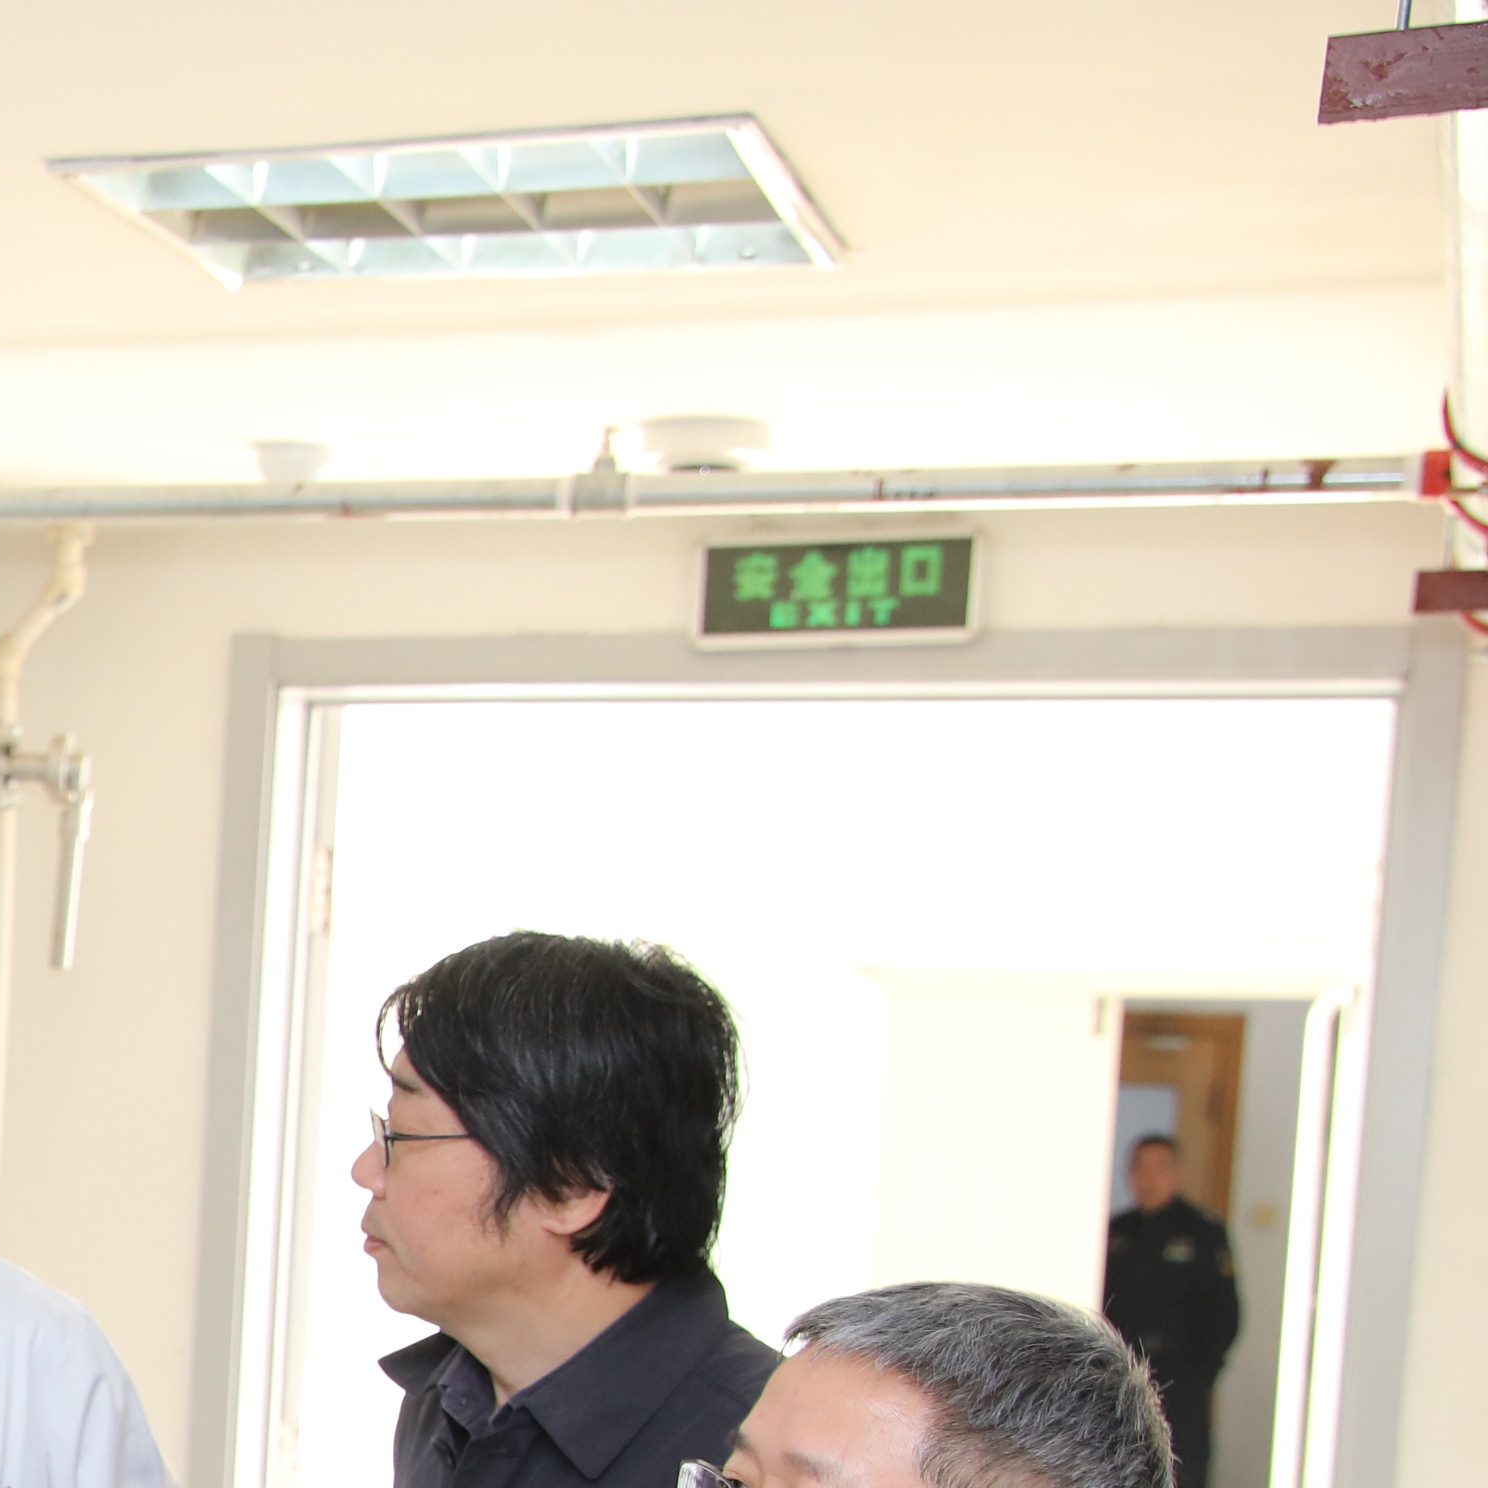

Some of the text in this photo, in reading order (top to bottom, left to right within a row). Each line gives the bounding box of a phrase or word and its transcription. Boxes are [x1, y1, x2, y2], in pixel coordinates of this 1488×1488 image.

[733, 546, 943, 602] 安全出口
[769, 596, 900, 629] EXIT
